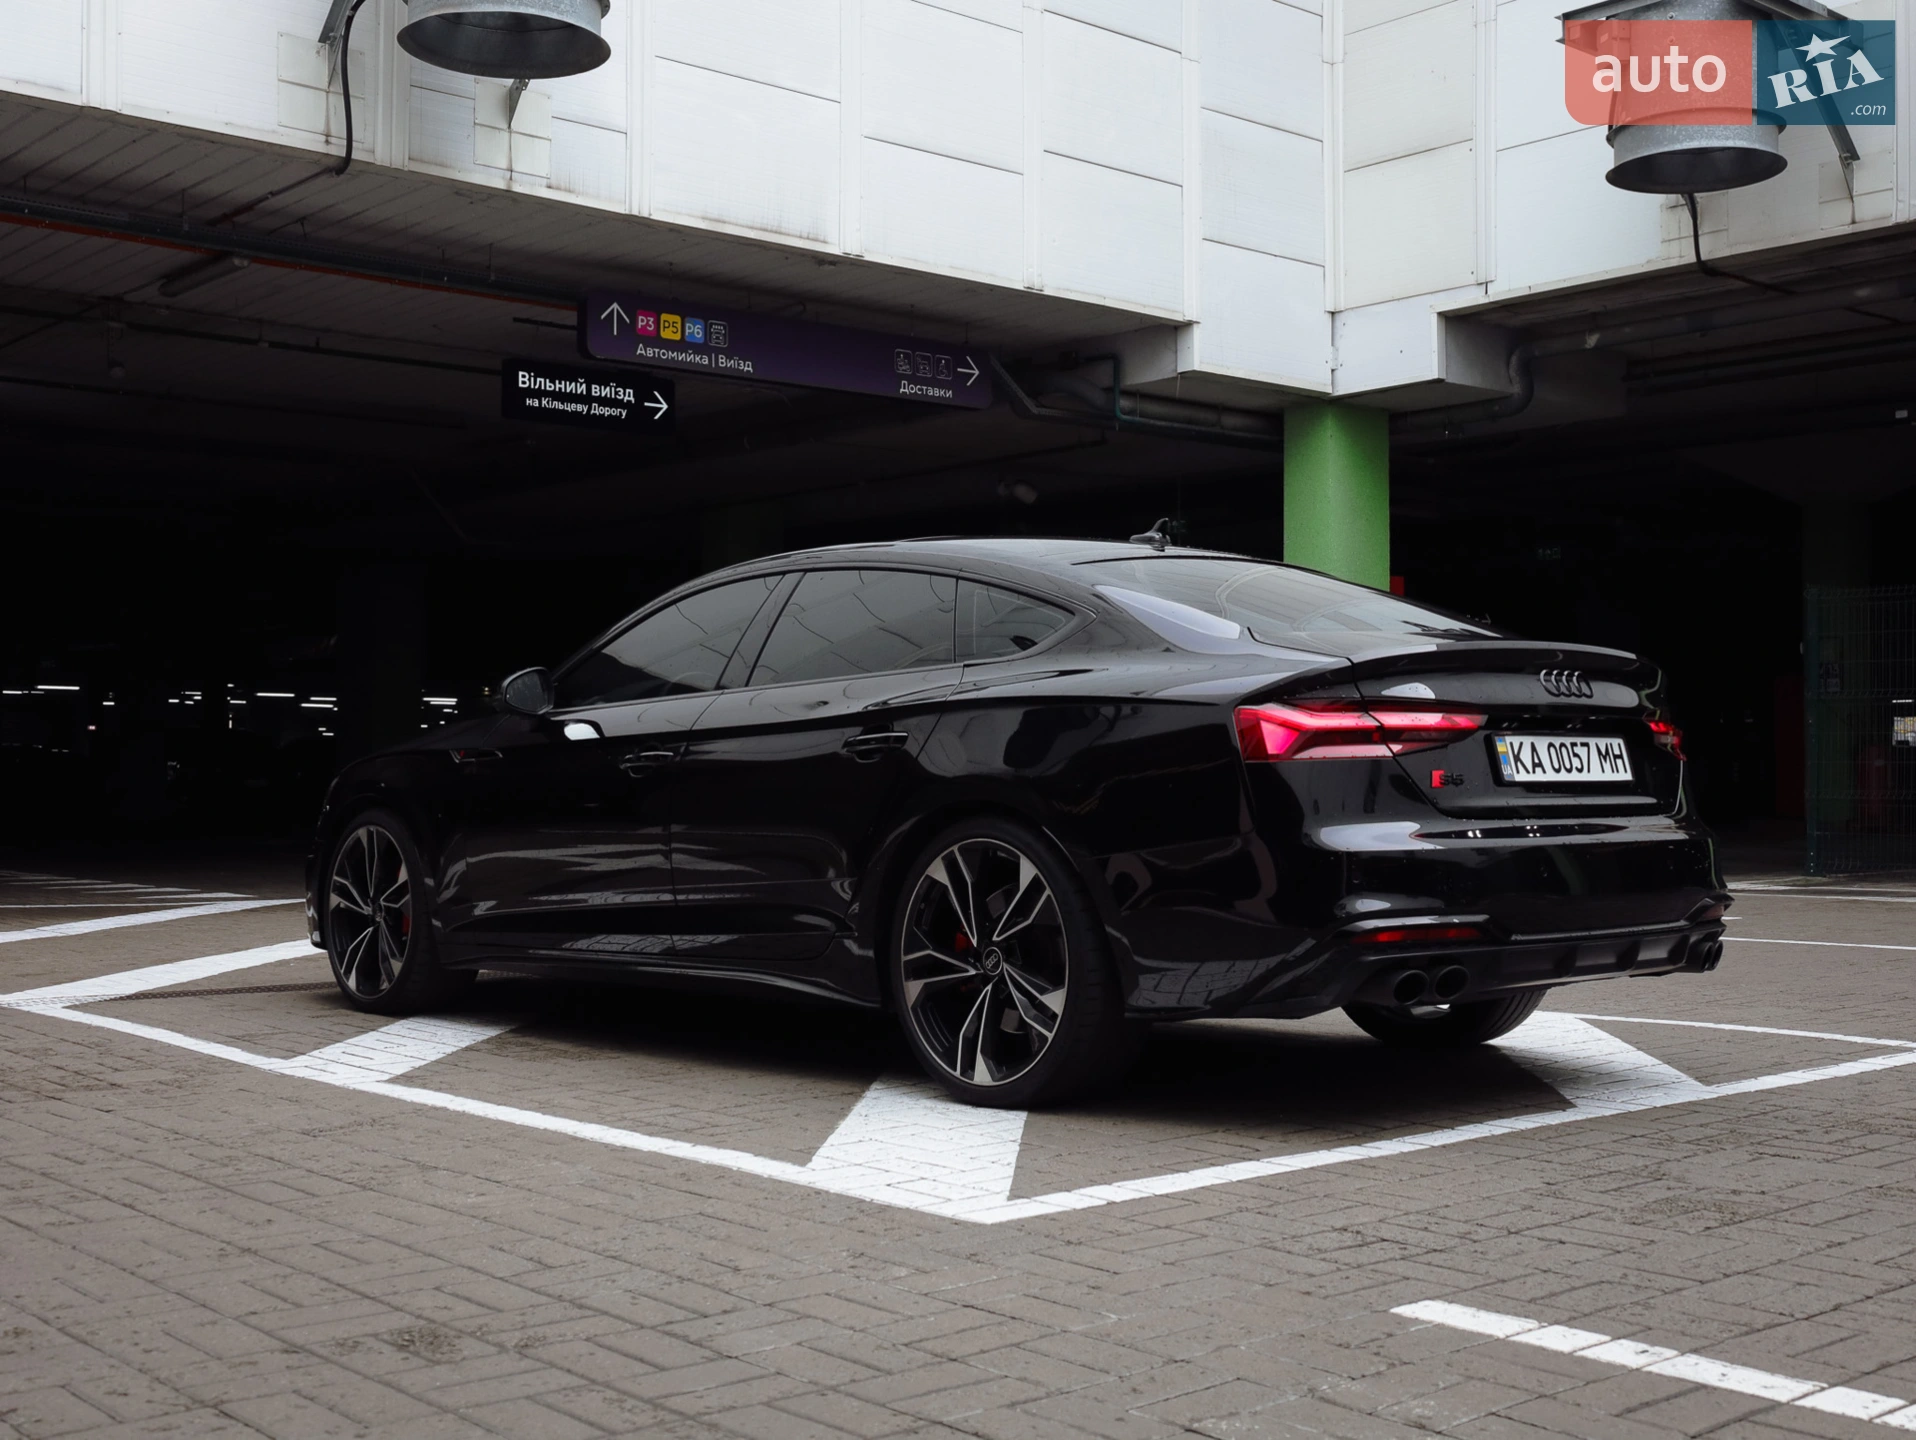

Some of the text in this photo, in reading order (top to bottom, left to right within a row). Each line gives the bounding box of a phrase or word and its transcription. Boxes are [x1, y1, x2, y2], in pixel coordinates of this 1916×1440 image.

[638, 315, 703, 338] P3 P5 P6
[636, 343, 709, 365] Автомийка
[718, 354, 753, 373] Виїзд
[518, 370, 635, 404] Вільний виїзд
[899, 380, 953, 398] Доставки
[526, 397, 628, 419] на Кільцеву Дорогу
[1509, 740, 1628, 775] KA 0057 MH
[1501, 764, 1513, 776] UA
